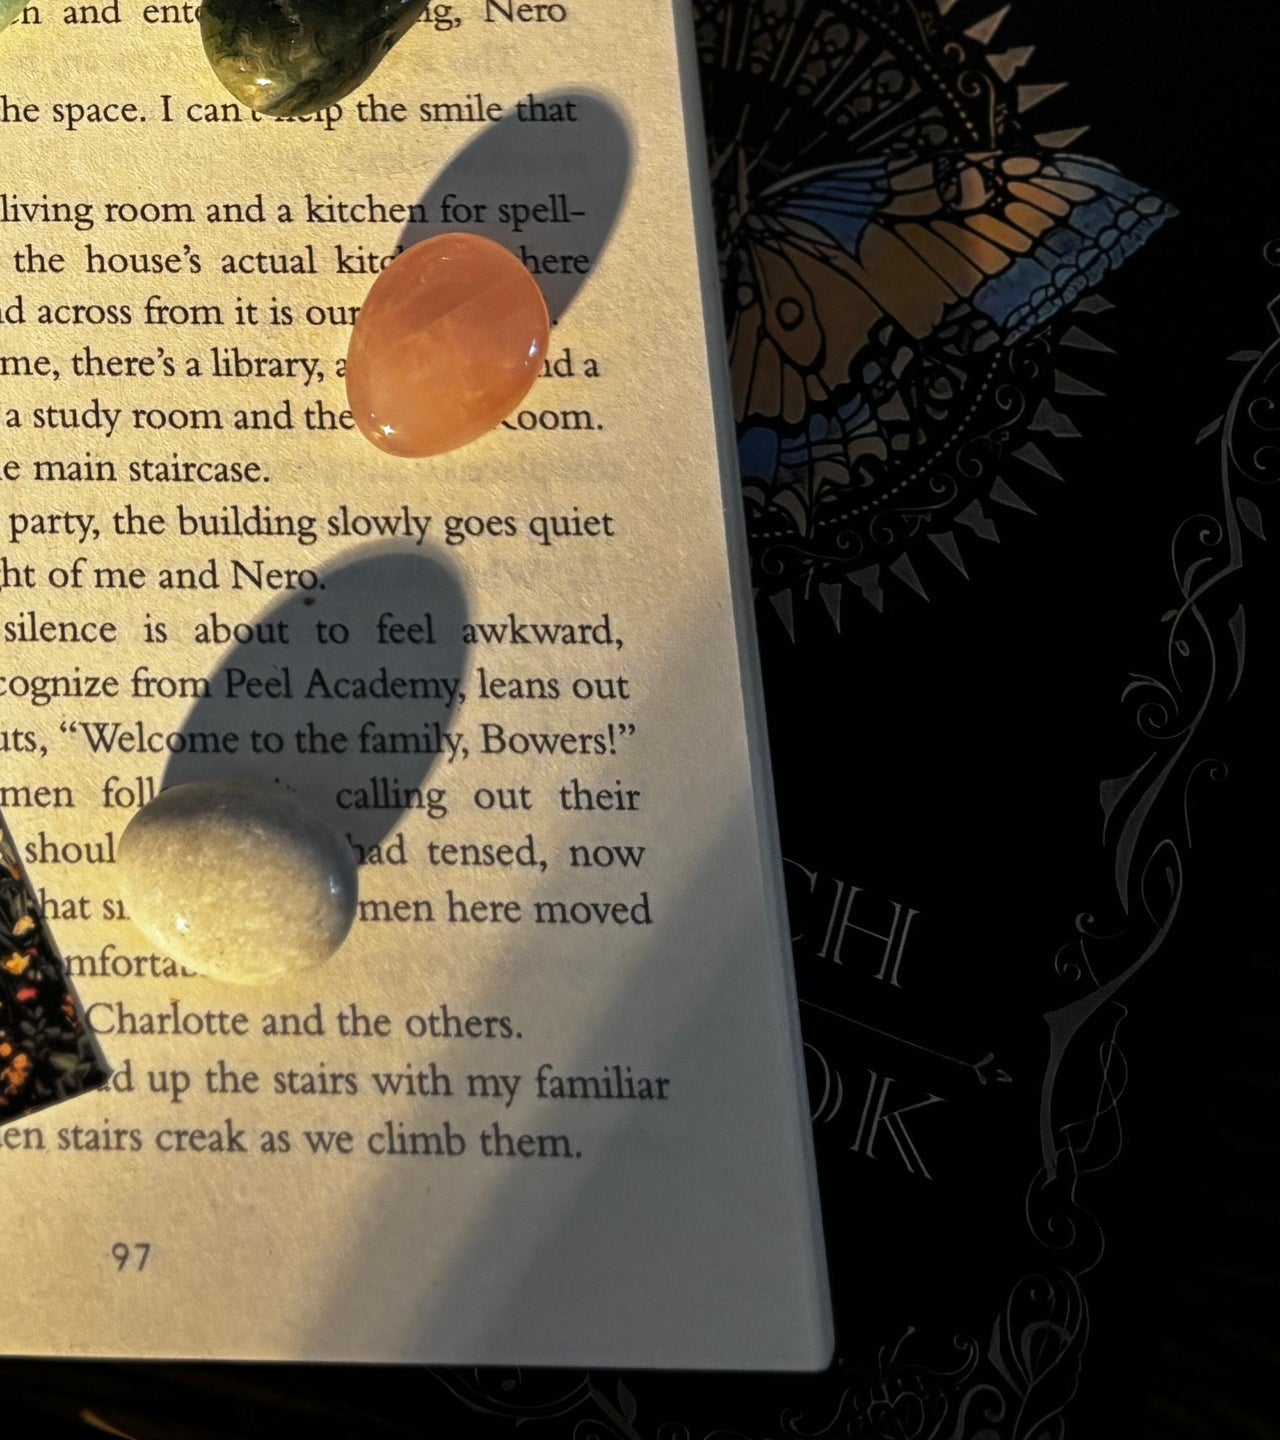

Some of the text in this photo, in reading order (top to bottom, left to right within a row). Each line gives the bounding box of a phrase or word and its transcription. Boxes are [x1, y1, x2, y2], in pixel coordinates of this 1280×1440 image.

[103, 202, 196, 224] room
[205, 192, 267, 225] and
[276, 203, 295, 224] a
[303, 192, 430, 225] kitchen
[439, 192, 489, 225] for
[32, 460, 118, 483] main
[128, 458, 271, 484] staircase.
[8, 510, 101, 545] party,
[112, 503, 167, 537] the
[175, 503, 319, 547] building
[326, 504, 433, 547] slowly
[443, 514, 518, 547] goes
[528, 512, 616, 548] quiet
[130, 665, 213, 699] from
[224, 666, 294, 700] Peel
[304, 666, 467, 710] Academy,
[476, 666, 562, 701] leans
[571, 675, 631, 701] out
[426, 833, 646, 873] tensed, now
[84, 998, 523, 1040] Charlotte and the others.
[111, 1241, 151, 1272] 97
